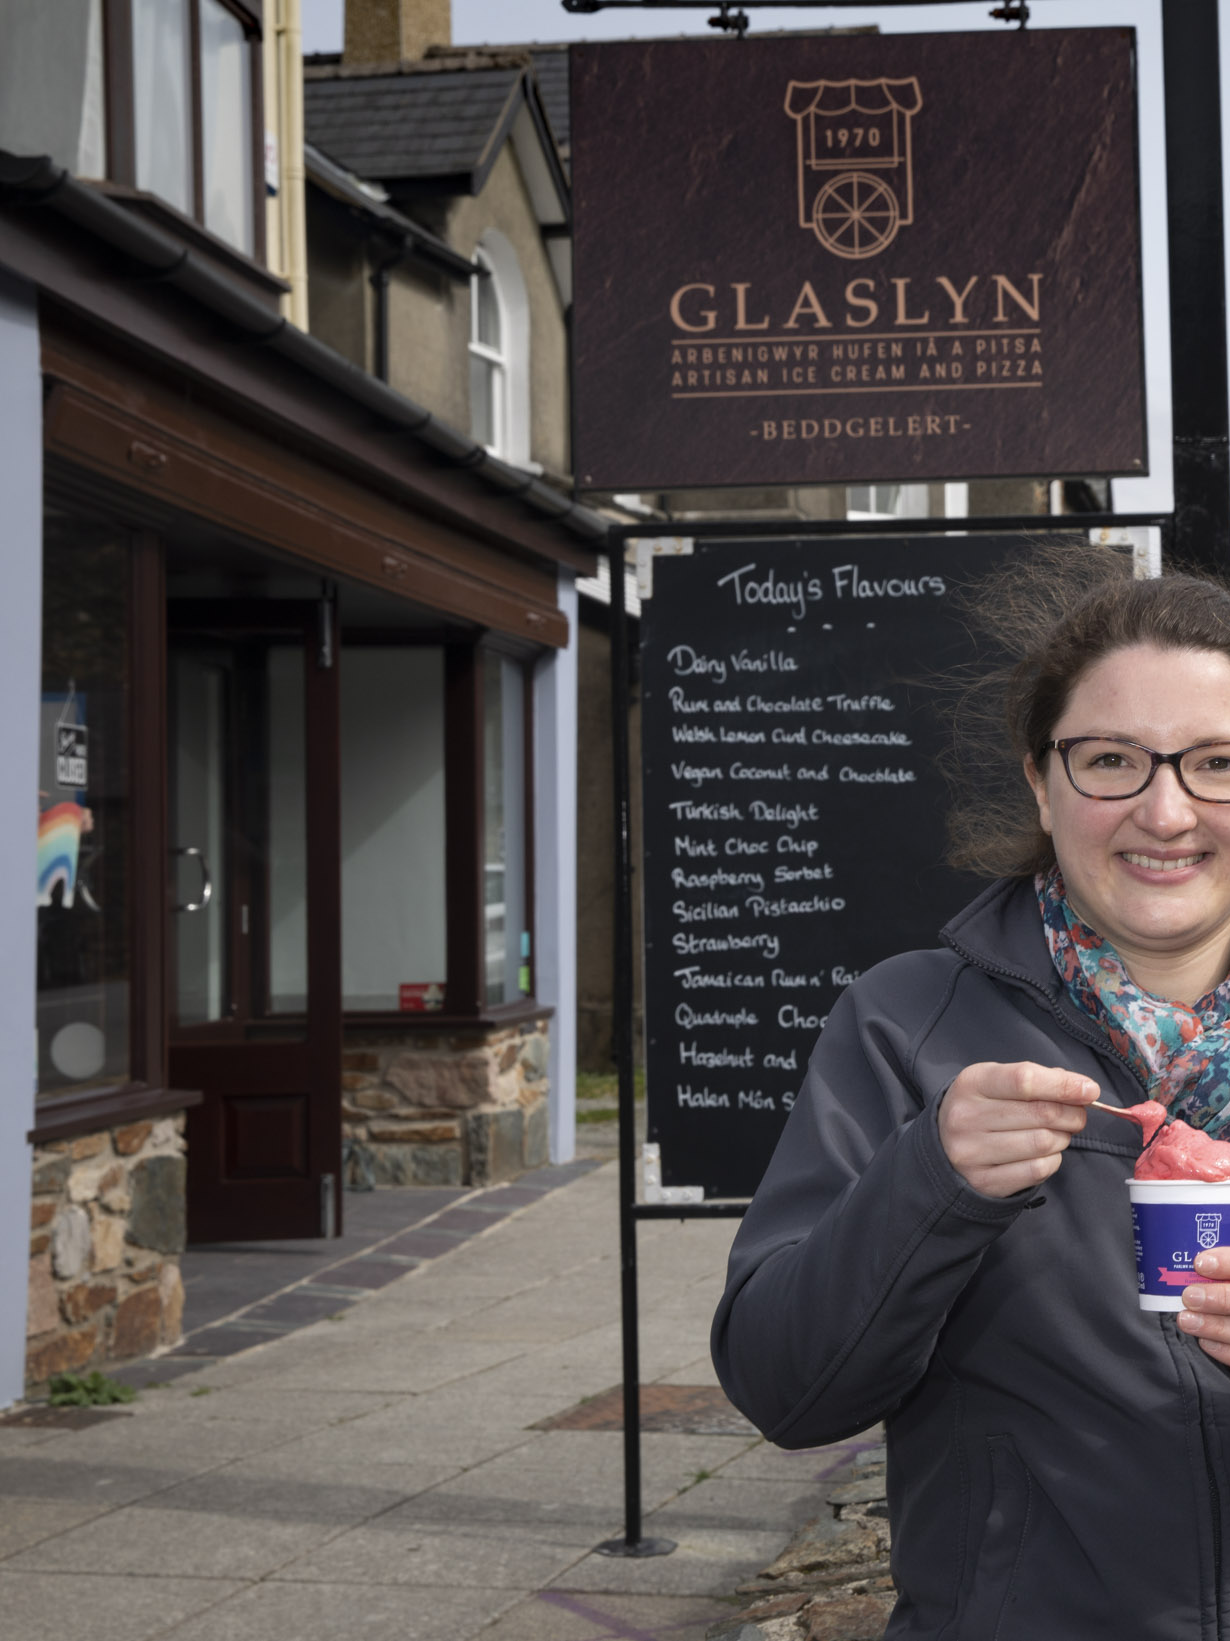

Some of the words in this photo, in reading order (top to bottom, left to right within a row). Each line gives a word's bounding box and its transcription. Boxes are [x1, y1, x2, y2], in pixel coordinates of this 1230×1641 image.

[825, 127, 881, 148] 1970
[669, 273, 1043, 332] GLASLYN
[671, 342, 819, 365] ARBENIGWYR
[832, 340, 904, 360] HUFEN
[950, 337, 964, 356] A
[975, 334, 1043, 355] PITSA
[671, 369, 769, 387] ARTISAN
[782, 366, 816, 384] ICE
[830, 364, 905, 382] CREAM
[919, 361, 963, 379] AND
[976, 359, 1043, 377] PIZZA
[716, 563, 823, 620] Today's
[831, 564, 946, 598] Flavours
[666, 644, 727, 684] Dairy
[730, 649, 799, 673] Vanilla
[668, 685, 710, 713] Rum
[713, 696, 742, 713] and
[746, 694, 824, 713] Chocolate
[826, 693, 895, 712] Truffle
[672, 724, 717, 743] Welsh
[719, 727, 766, 744] Lemon
[771, 726, 807, 745] Curd
[811, 729, 912, 746] Cheesecake
[671, 761, 724, 787] Vegan
[729, 761, 791, 780] Coconut
[796, 765, 829, 781] and
[668, 800, 743, 820] Turkish
[748, 800, 819, 829] Delight
[674, 835, 718, 857] Mint
[724, 837, 769, 856] Choc
[776, 835, 819, 858] Chip
[671, 867, 765, 892] Raspberry
[774, 863, 833, 883] Sorbet
[672, 900, 739, 923] Sicilian
[671, 932, 780, 959] Strawberry
[673, 965, 765, 989] Jamaican
[674, 1002, 759, 1030] Quadruple
[679, 1041, 755, 1069] Hazelnut
[763, 1050, 798, 1071] and
